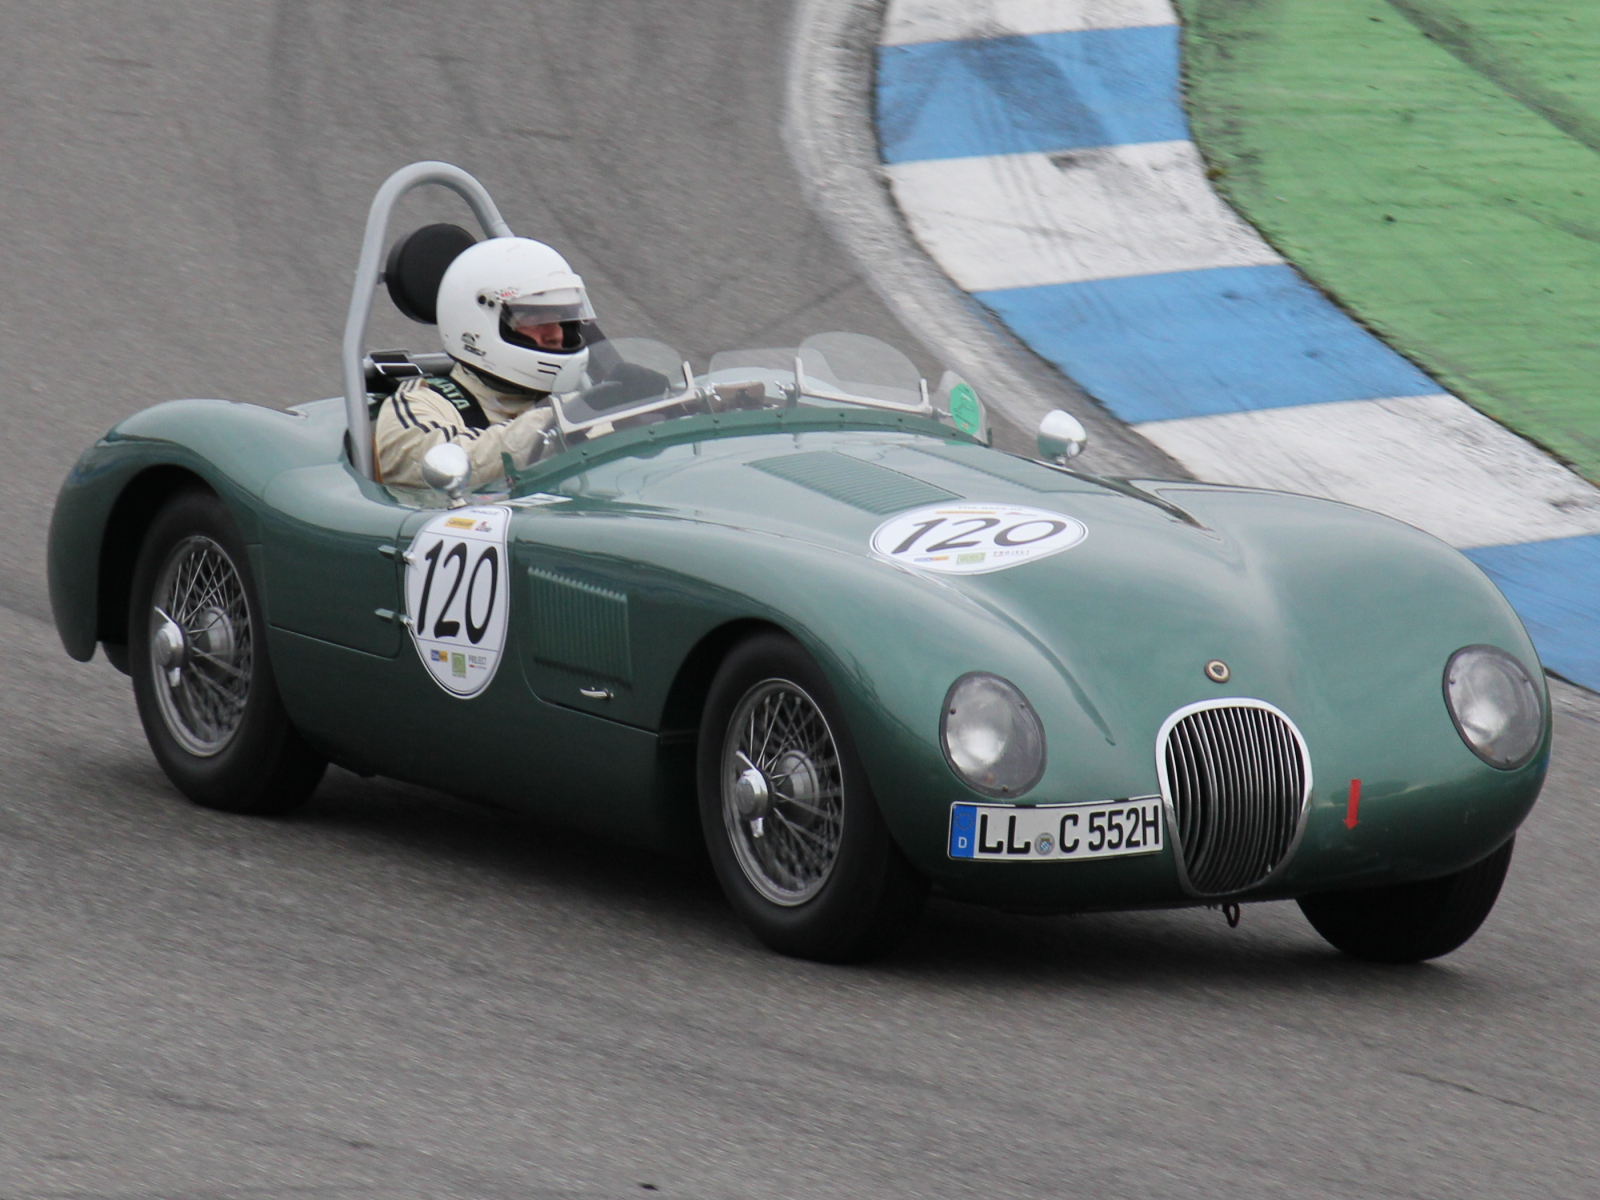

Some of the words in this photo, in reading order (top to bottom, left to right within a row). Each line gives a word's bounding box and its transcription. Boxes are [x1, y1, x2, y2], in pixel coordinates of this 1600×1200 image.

[890, 517, 1067, 555] 120
[417, 538, 498, 645] 120
[957, 836, 968, 849] D
[978, 813, 1031, 855] LL
[1059, 813, 1080, 853] C
[1088, 804, 1160, 852] 552H
